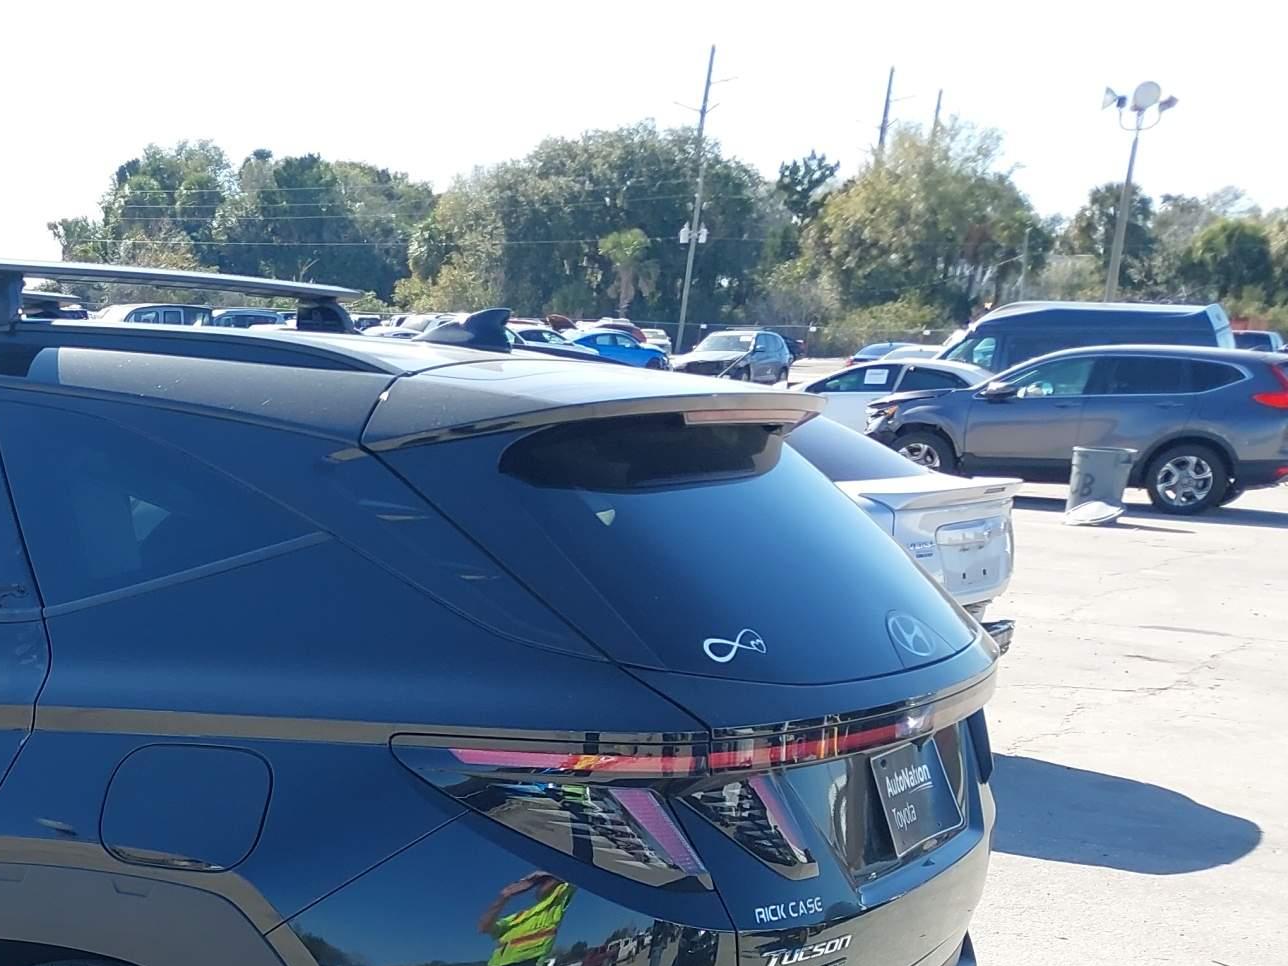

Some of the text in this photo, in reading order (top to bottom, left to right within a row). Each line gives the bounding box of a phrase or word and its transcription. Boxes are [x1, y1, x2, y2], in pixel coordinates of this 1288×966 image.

[885, 764, 932, 798] AutoNation
[892, 802, 917, 831] Toyota
[755, 896, 823, 924] RICK CASE
